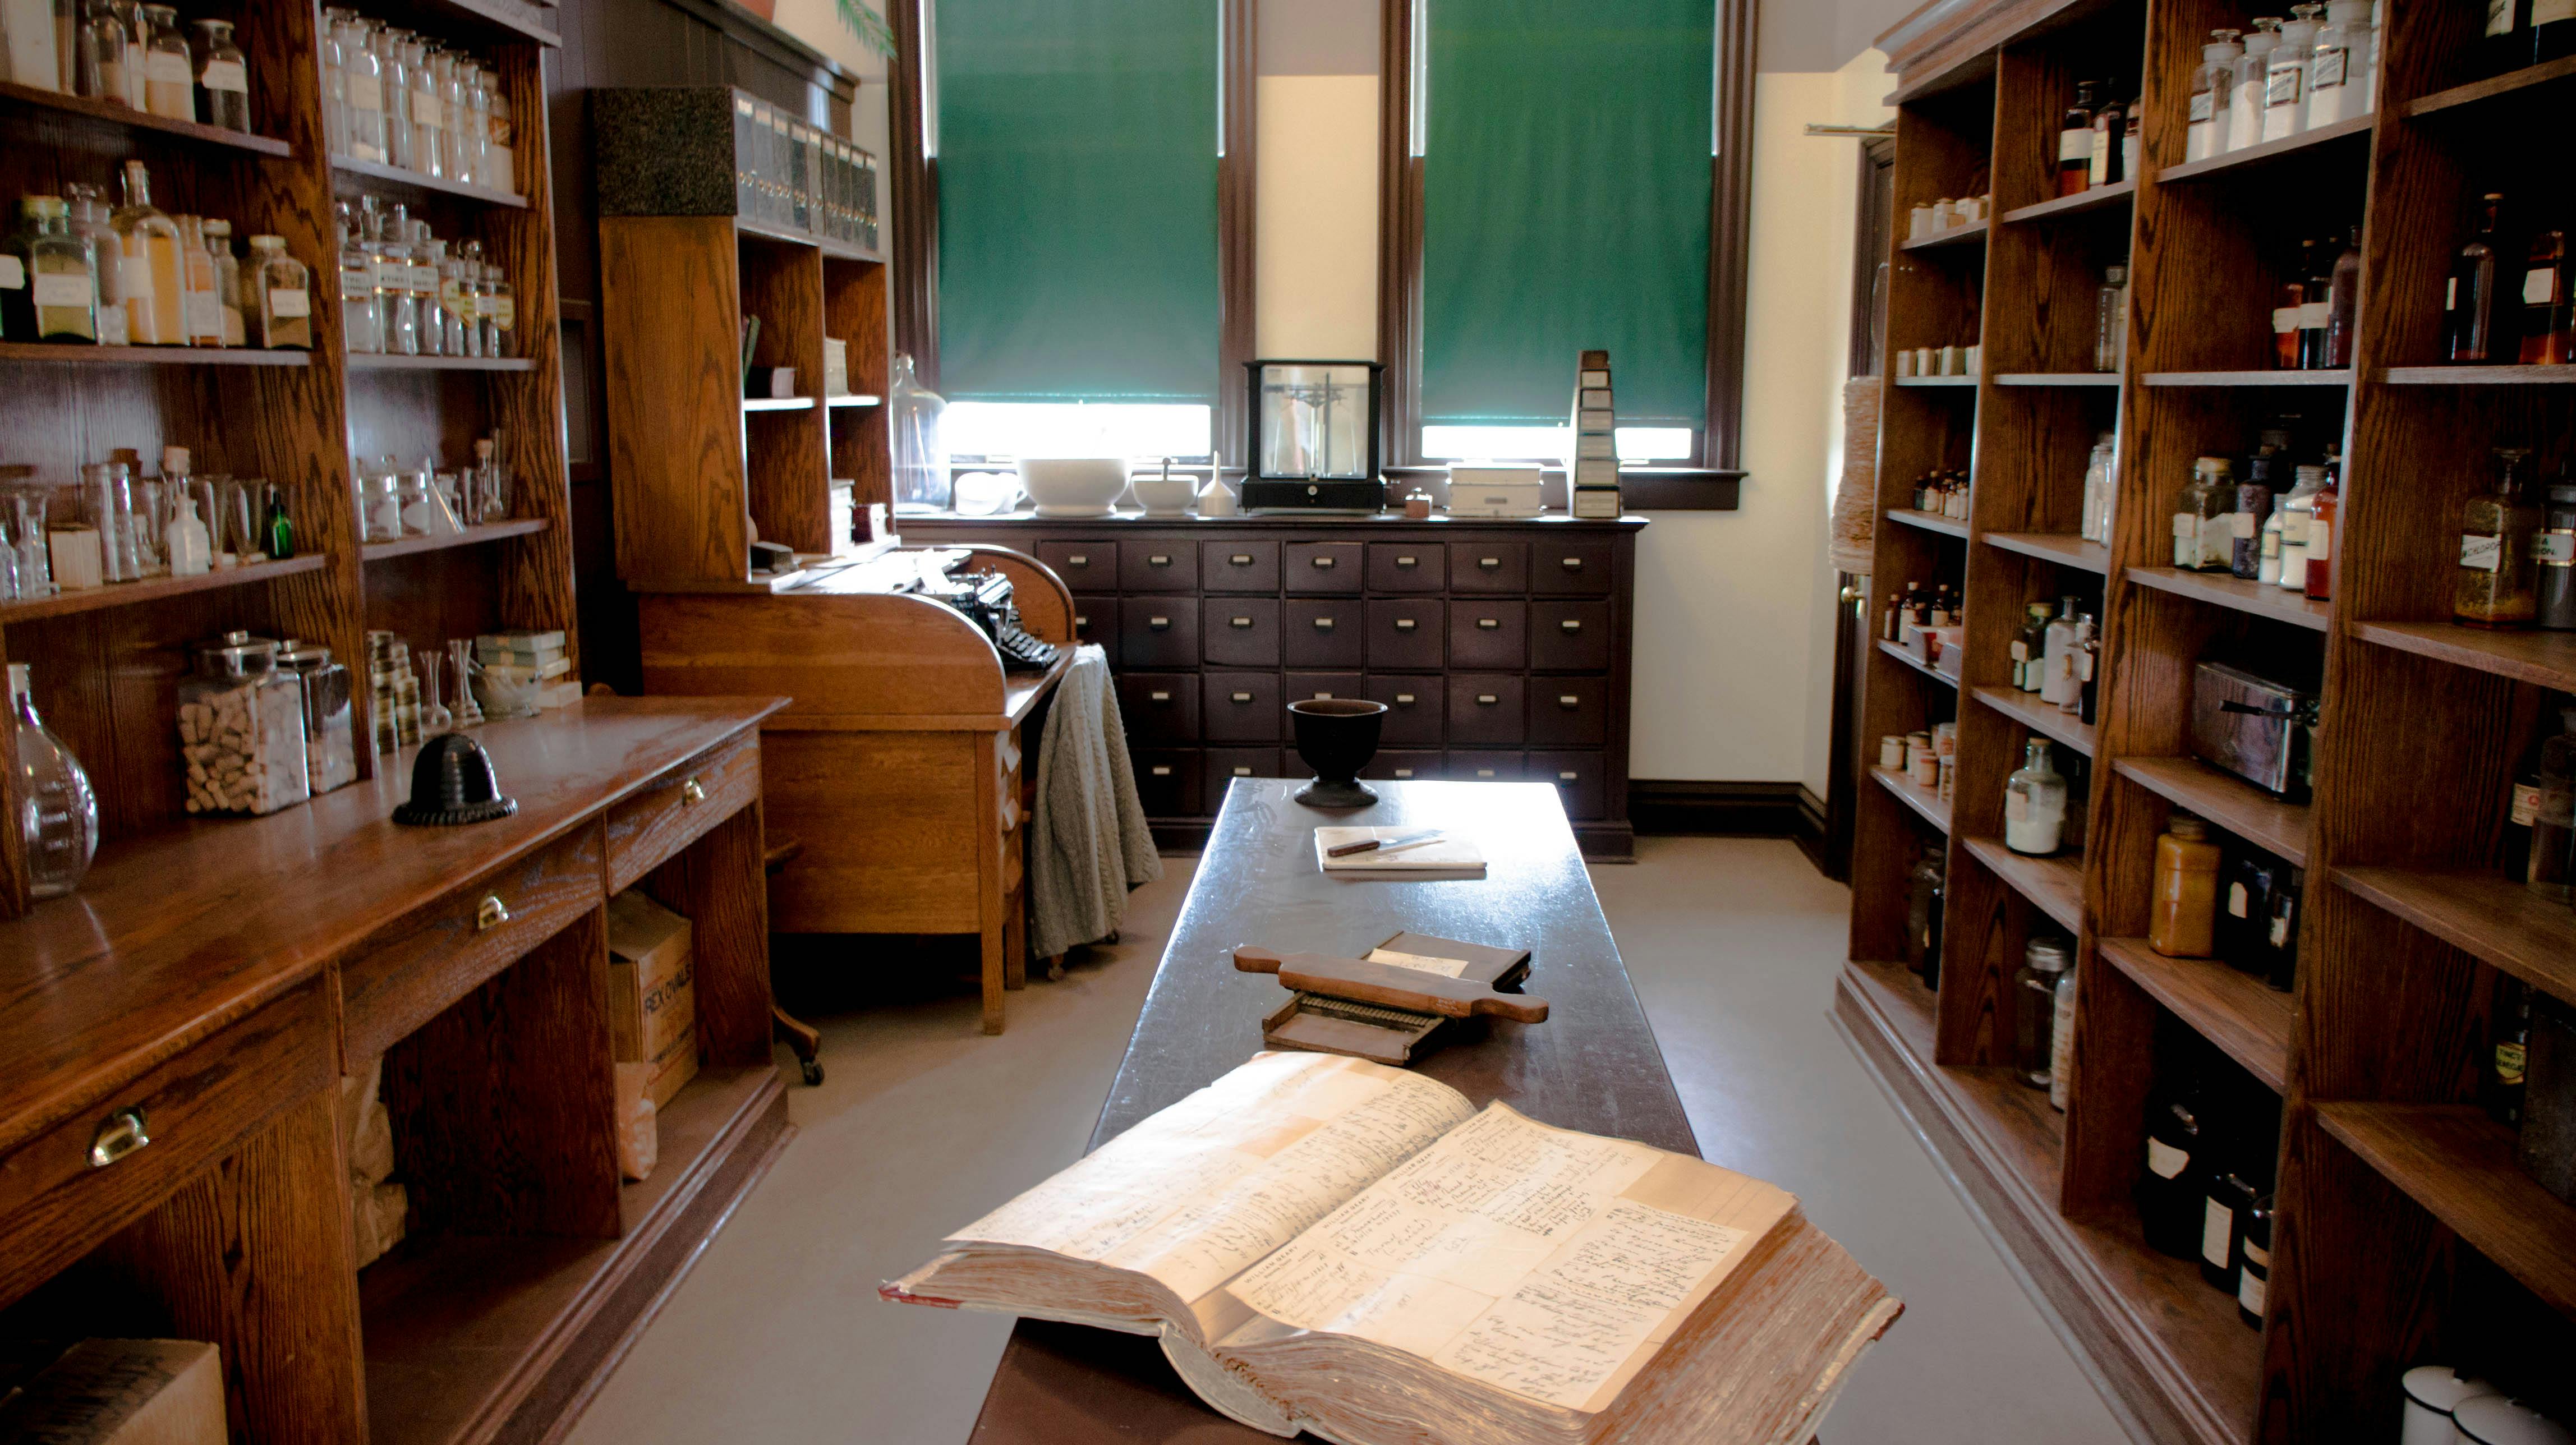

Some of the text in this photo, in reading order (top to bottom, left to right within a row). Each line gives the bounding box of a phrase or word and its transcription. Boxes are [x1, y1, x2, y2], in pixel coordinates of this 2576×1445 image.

[1391, 1162, 1416, 1181] WILLIAM
[1321, 1194, 1370, 1230] WILLIAM GEARY
[1243, 1244, 1299, 1285] WILLIAM GEARY
